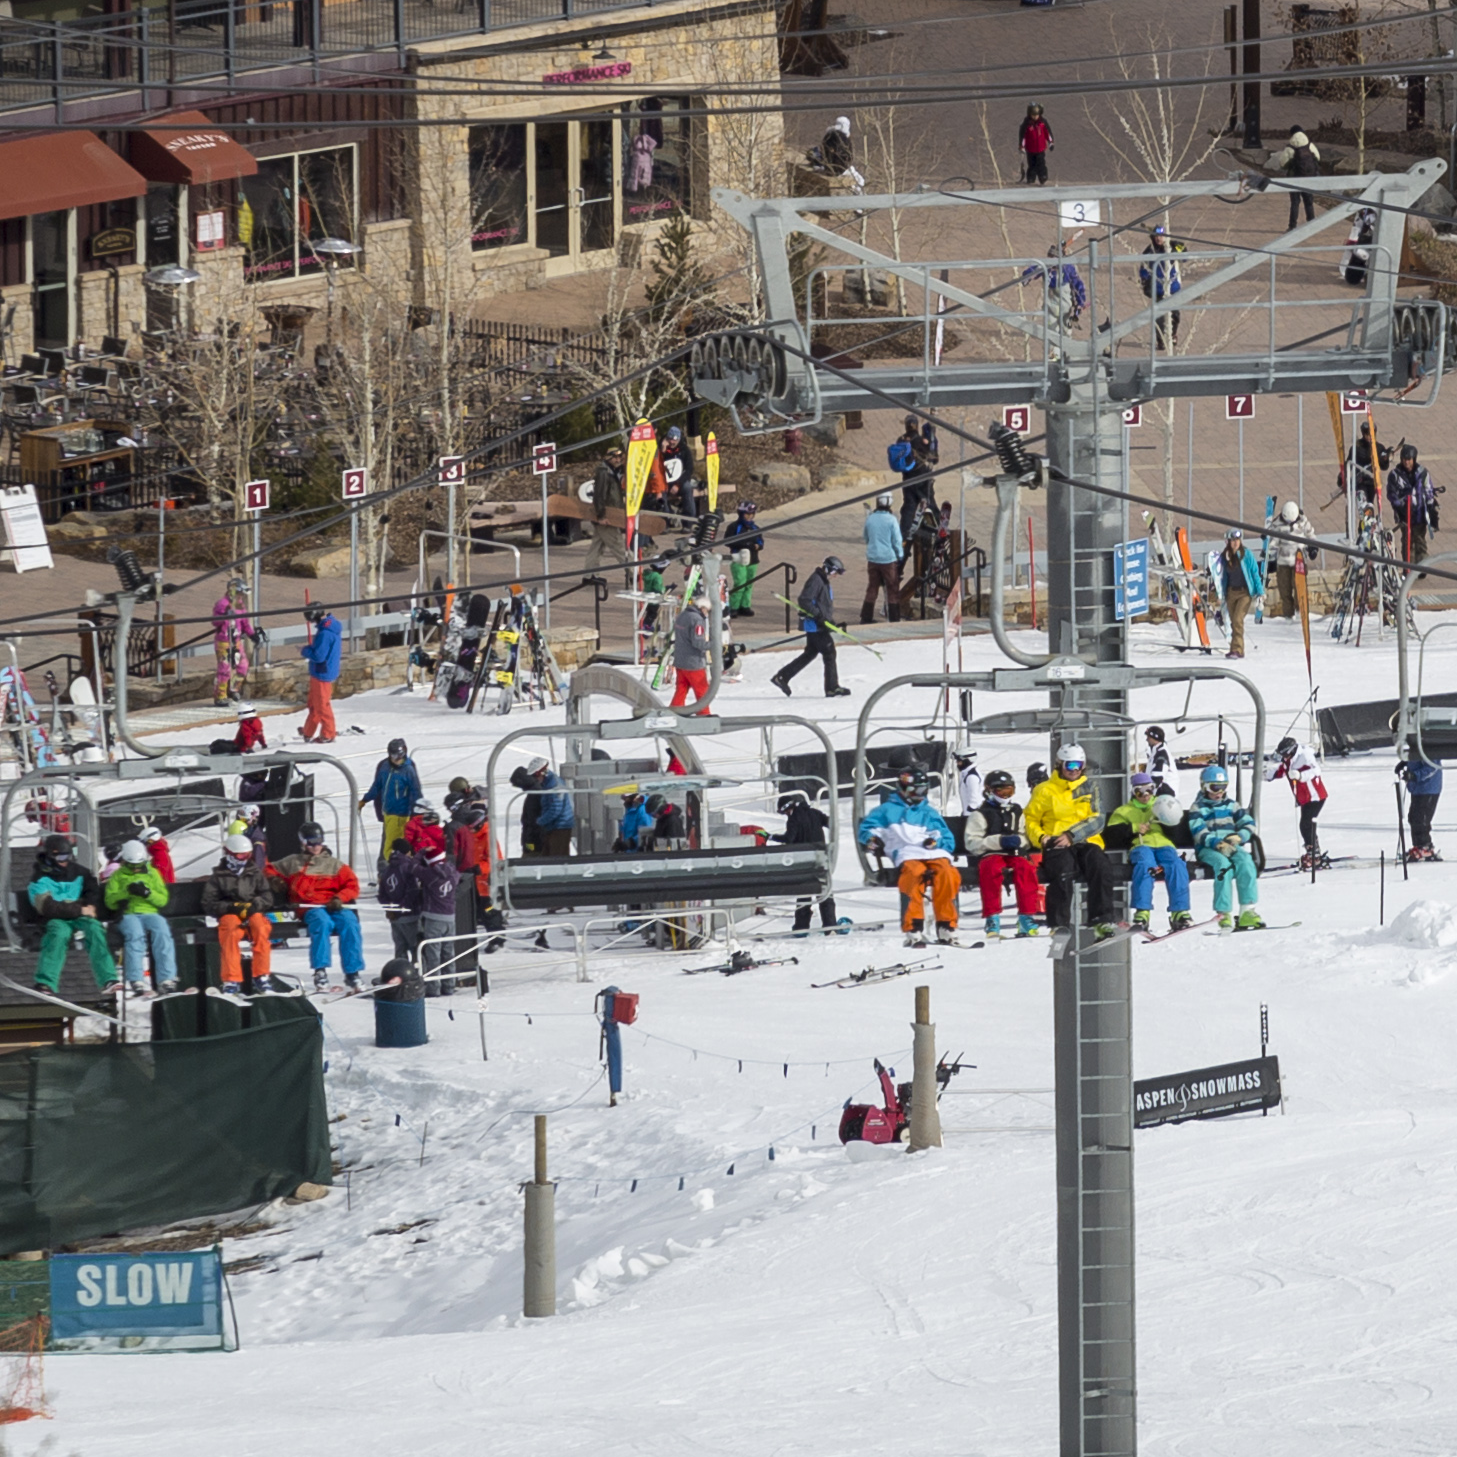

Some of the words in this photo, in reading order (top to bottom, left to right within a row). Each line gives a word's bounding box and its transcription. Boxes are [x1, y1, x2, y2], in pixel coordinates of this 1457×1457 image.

[1074, 203, 1085, 222] 3
[1234, 397, 1246, 413] 7
[1011, 410, 1022, 429] 5
[539, 450, 550, 467] 4
[446, 463, 457, 479] 3
[349, 475, 360, 491] 2
[253, 487, 262, 503] 1
[1136, 1087, 1175, 1111] ASPEN
[1191, 1070, 1261, 1100] SNOWMASS
[77, 1262, 193, 1307] SLOW
